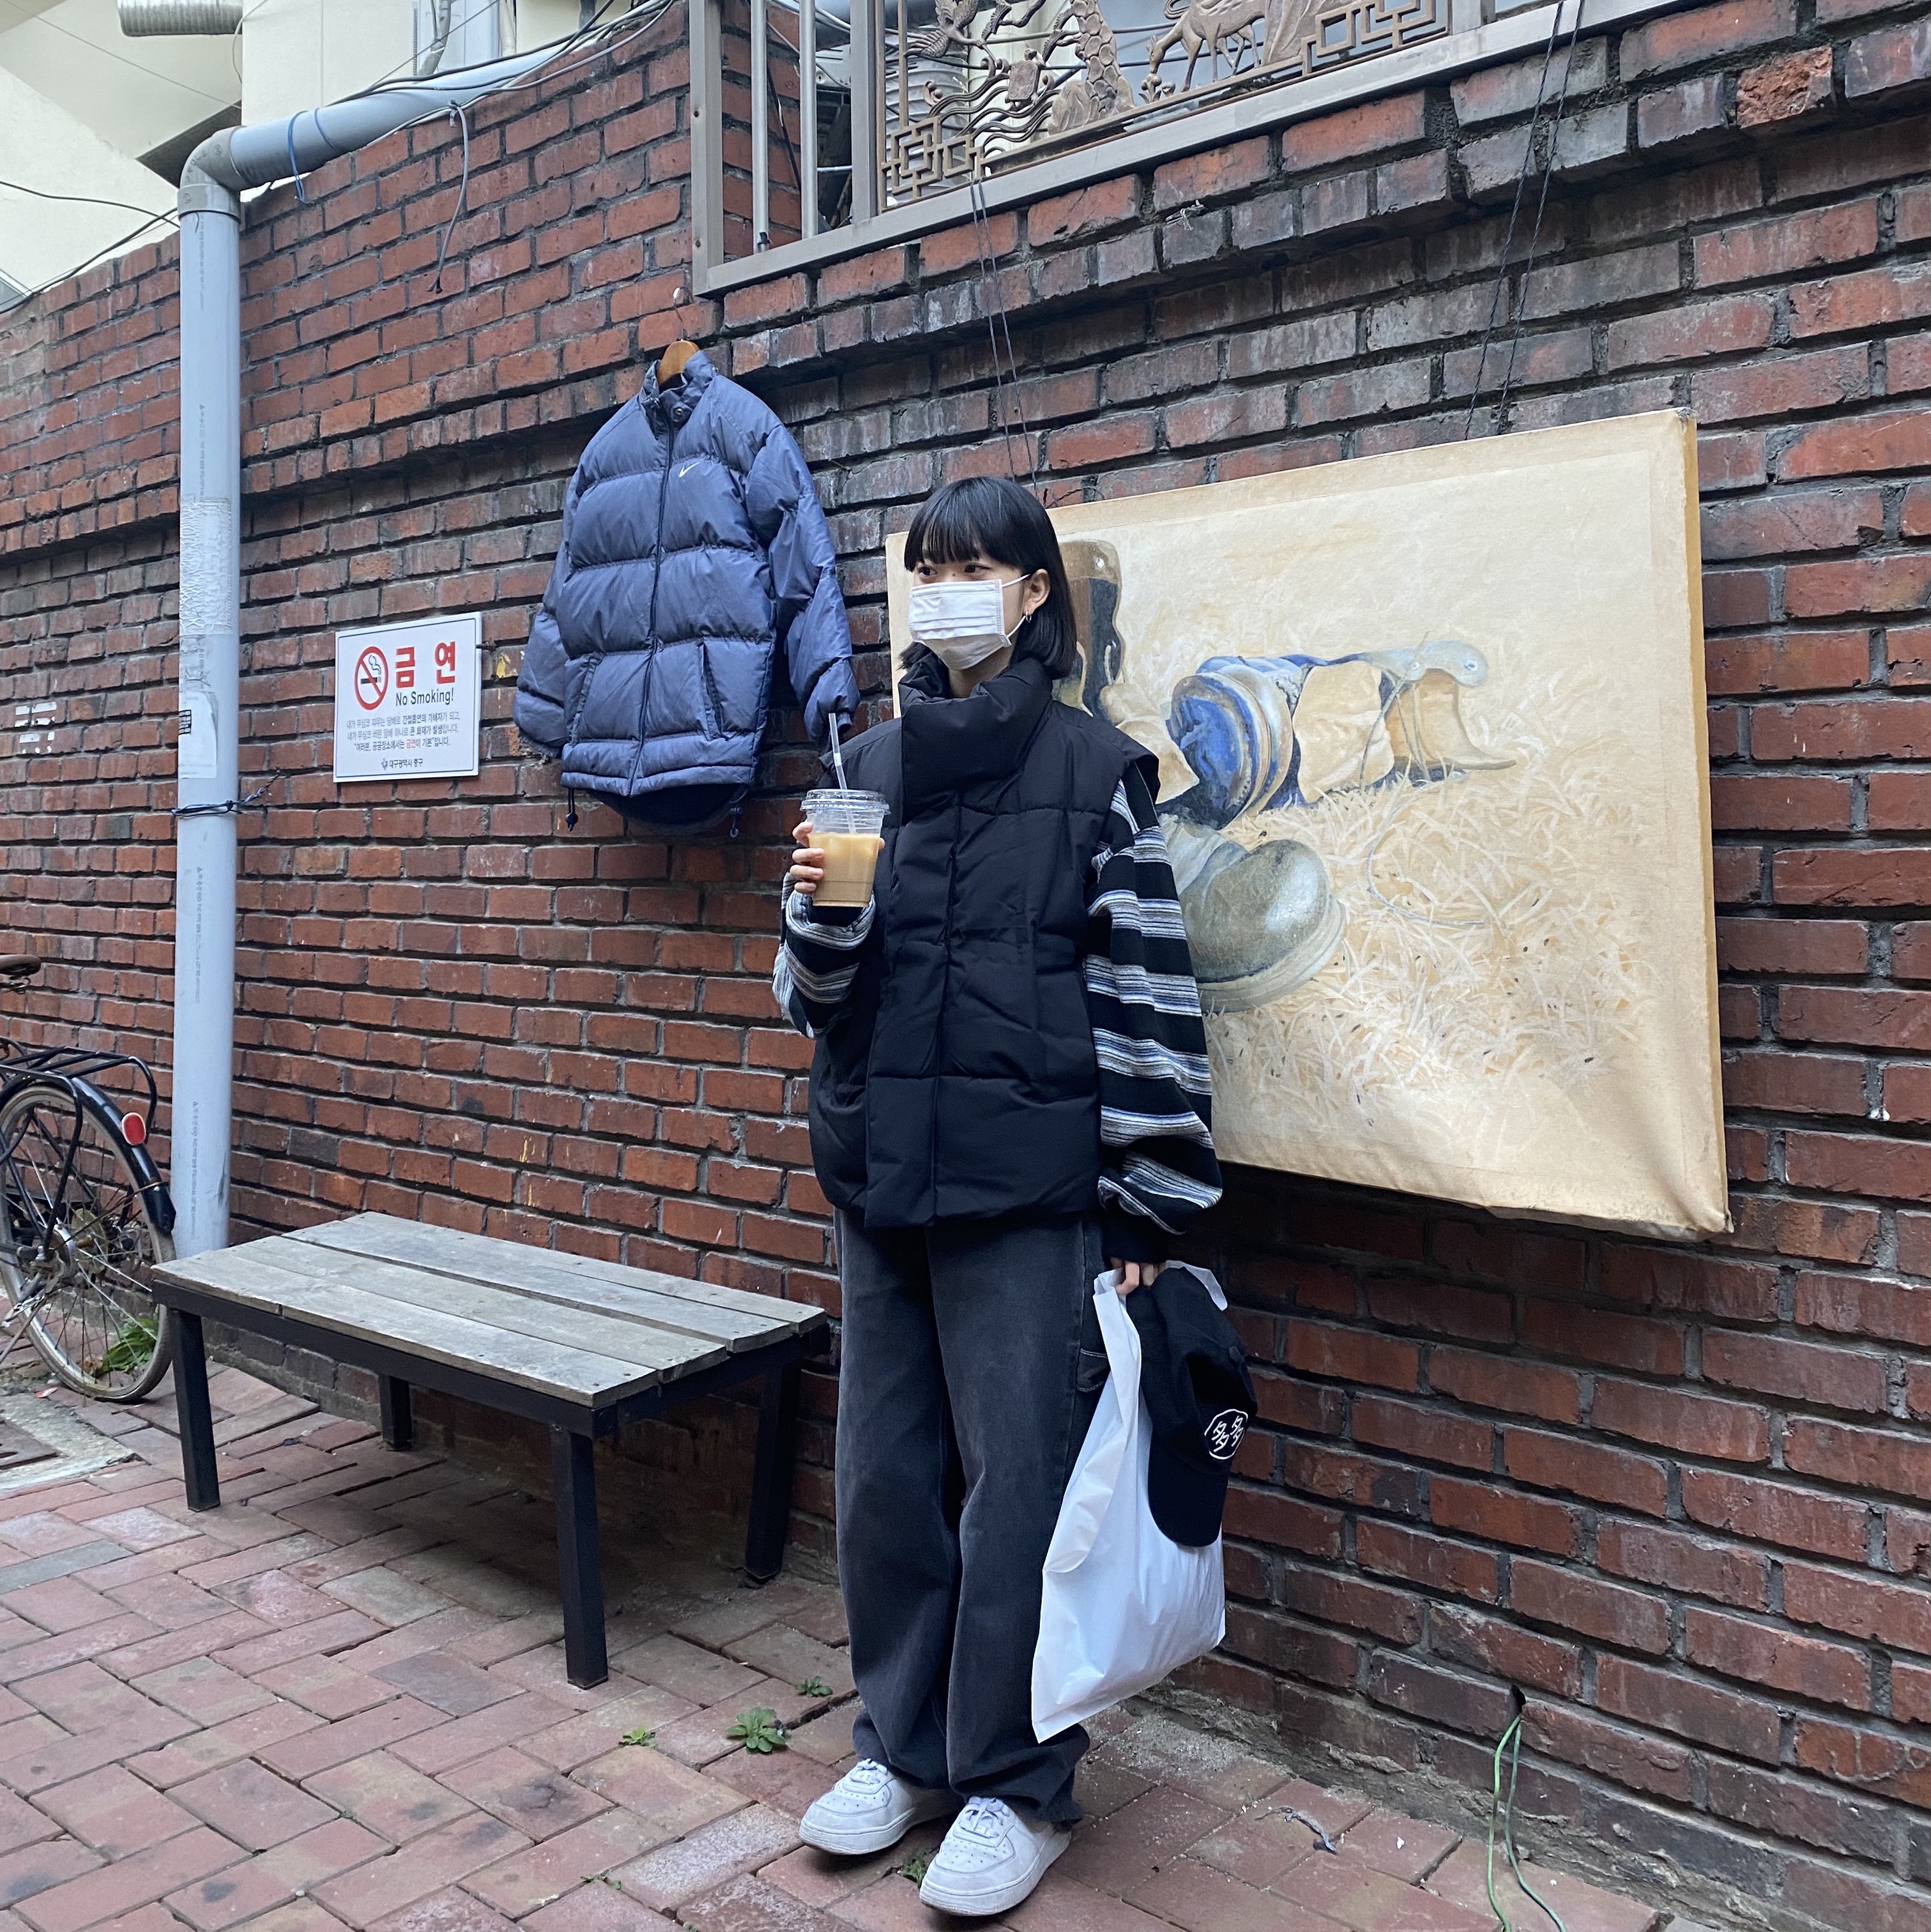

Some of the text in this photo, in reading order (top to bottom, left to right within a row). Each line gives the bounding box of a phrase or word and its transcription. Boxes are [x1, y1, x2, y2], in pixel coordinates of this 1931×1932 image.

[396, 688, 454, 706] No Smoking!
[347, 720, 355, 729] 내가
[356, 719, 370, 728] 무심코
[372, 717, 385, 726] 피우는
[387, 717, 401, 726] 담배로
[403, 713, 426, 724] 간접흡연의
[428, 711, 447, 722] 가해자가
[347, 731, 356, 740] 내가
[358, 731, 370, 740] 무심코
[373, 729, 381, 738] 버린
[384, 728, 392, 738] 담배
[395, 727, 408, 737] 하나로
[410, 727, 415, 736] 큰
[416, 726, 431, 735] 화재가
[372, 740, 404, 750] 공공장소에서는
[406, 738, 420, 749] 금연이
[390, 758, 423, 768] 대구광역시 중구
